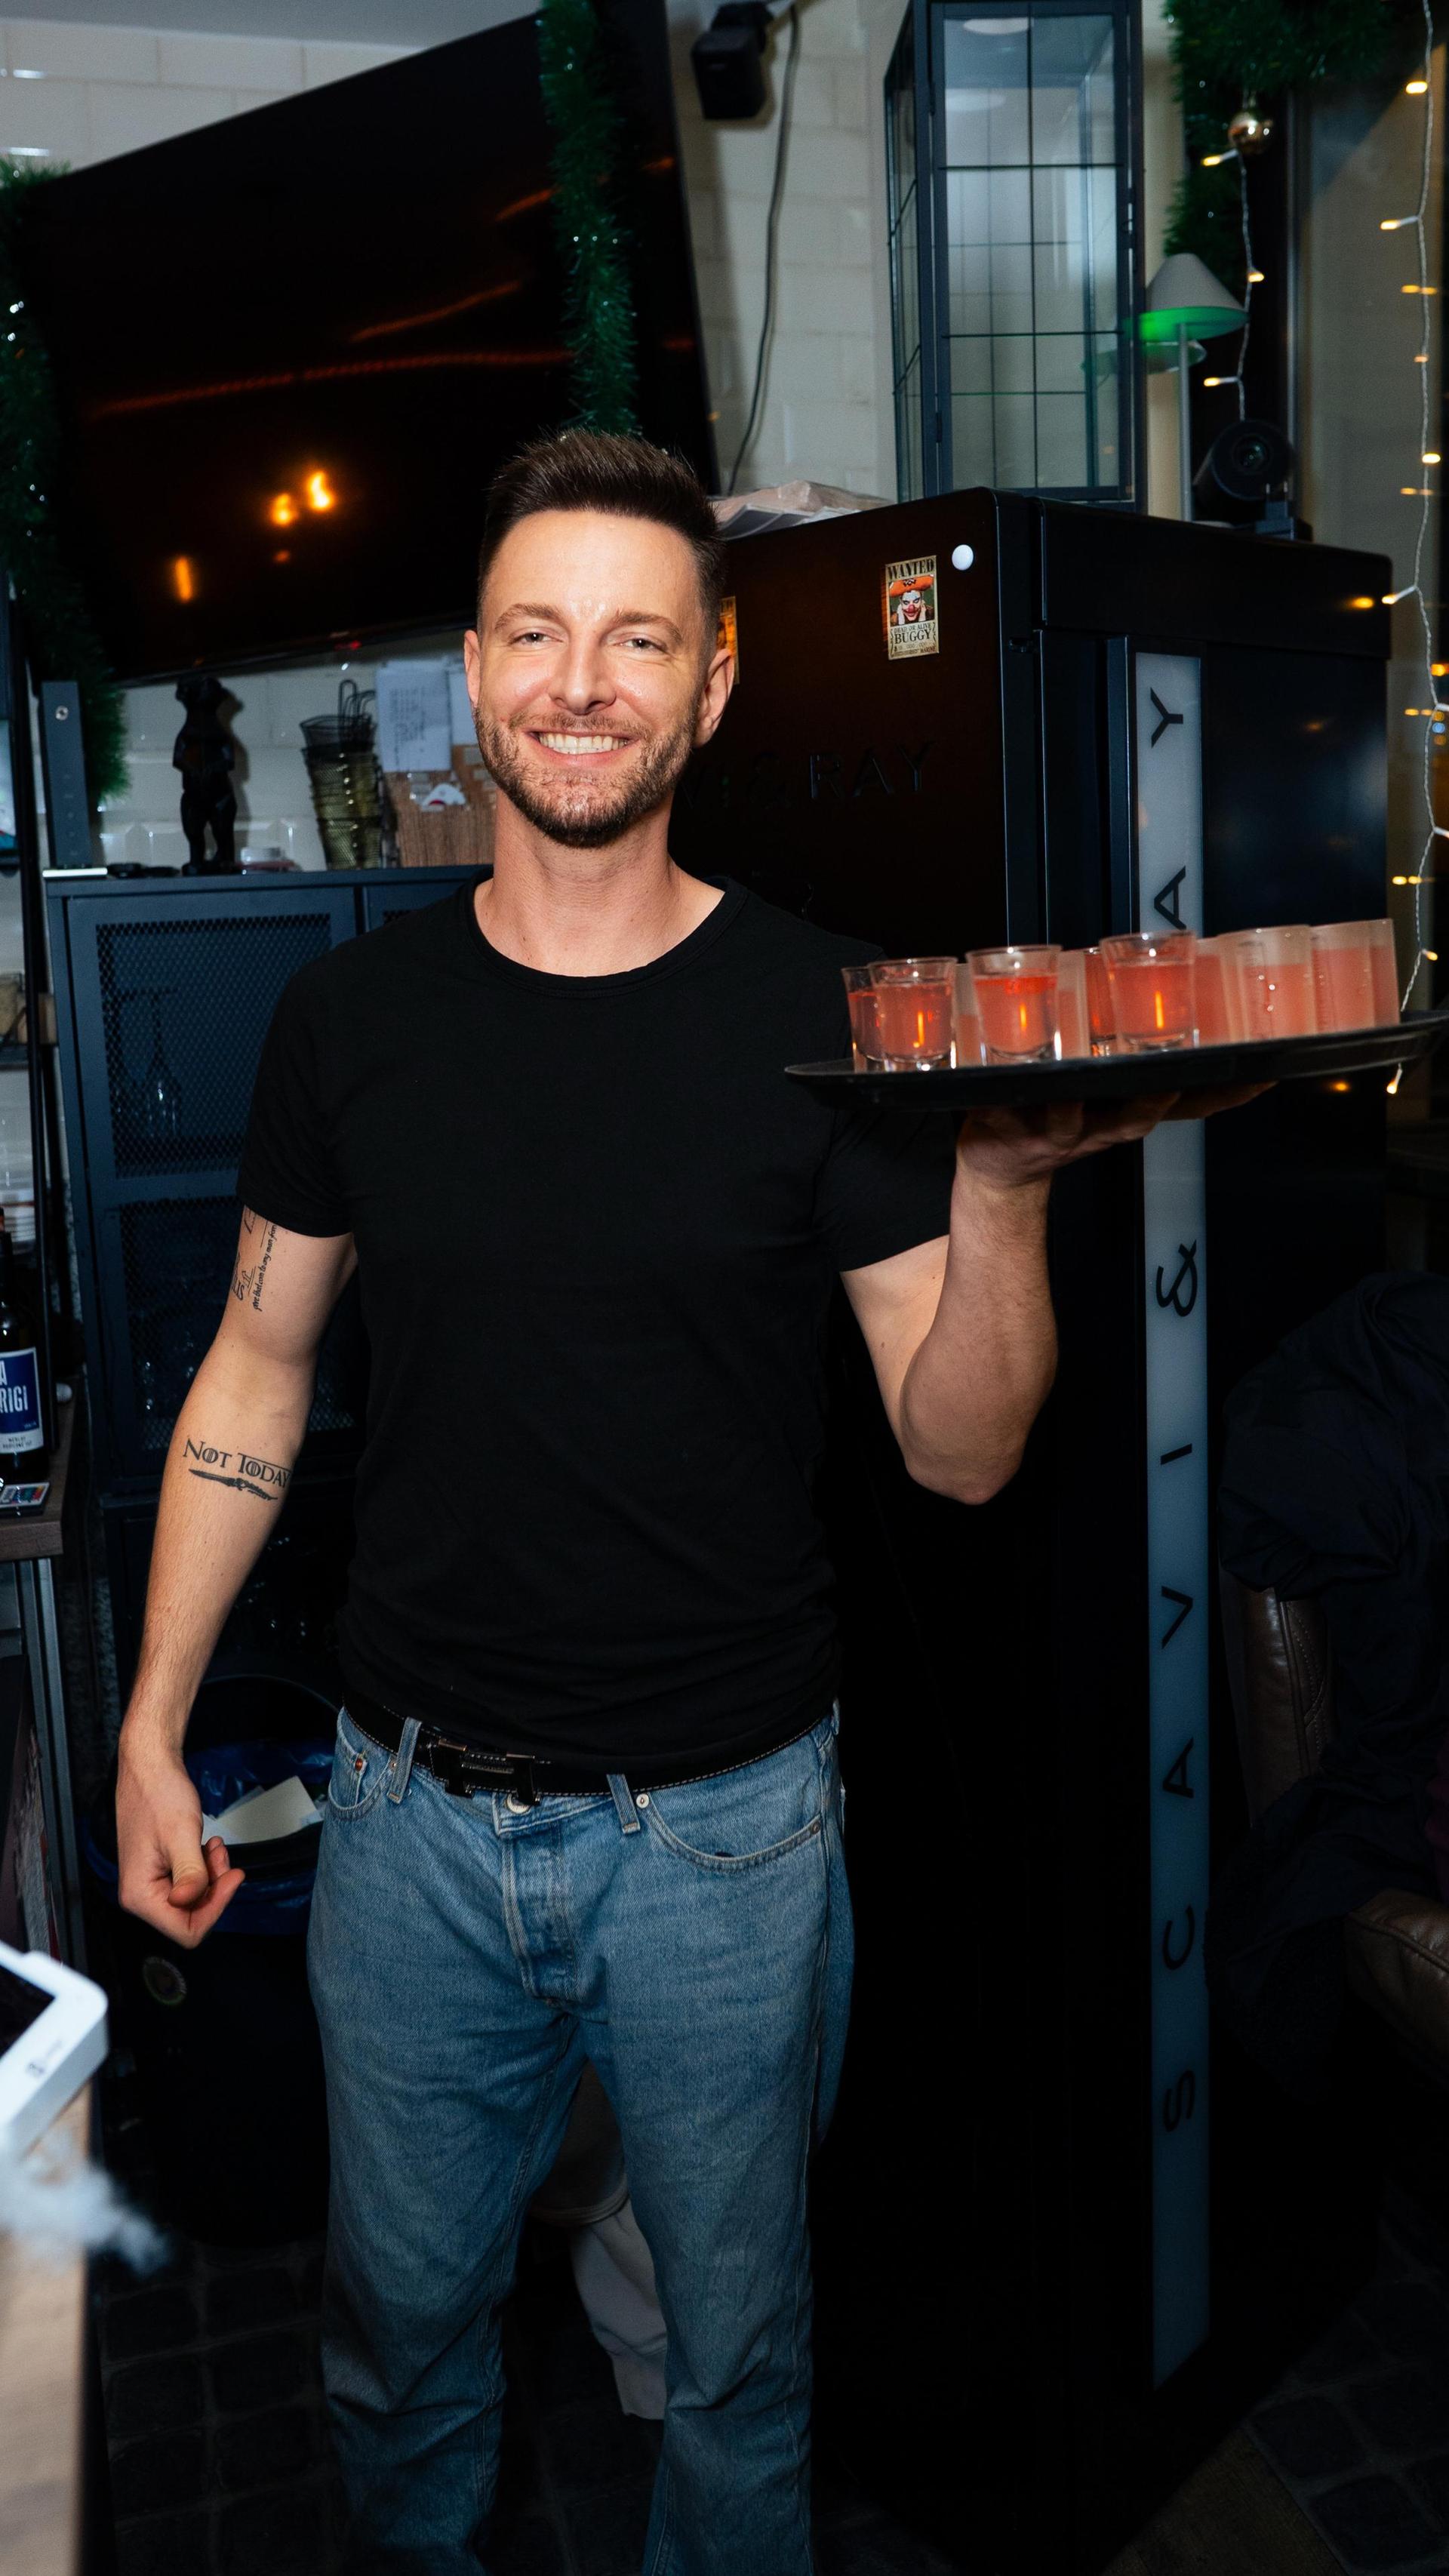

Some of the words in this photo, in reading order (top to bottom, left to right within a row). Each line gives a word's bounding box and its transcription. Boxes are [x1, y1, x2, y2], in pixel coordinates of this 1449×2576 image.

[887, 559, 934, 580] WANTED
[894, 628, 931, 645] BUGGY
[810, 740, 937, 800] RAY
[1149, 686, 1188, 931] AY
[1157, 1239, 1198, 1318] &
[183, 1438, 232, 1468] NOT
[238, 1452, 292, 1488] TODAY
[1160, 1442, 1195, 2132] SCAVI
